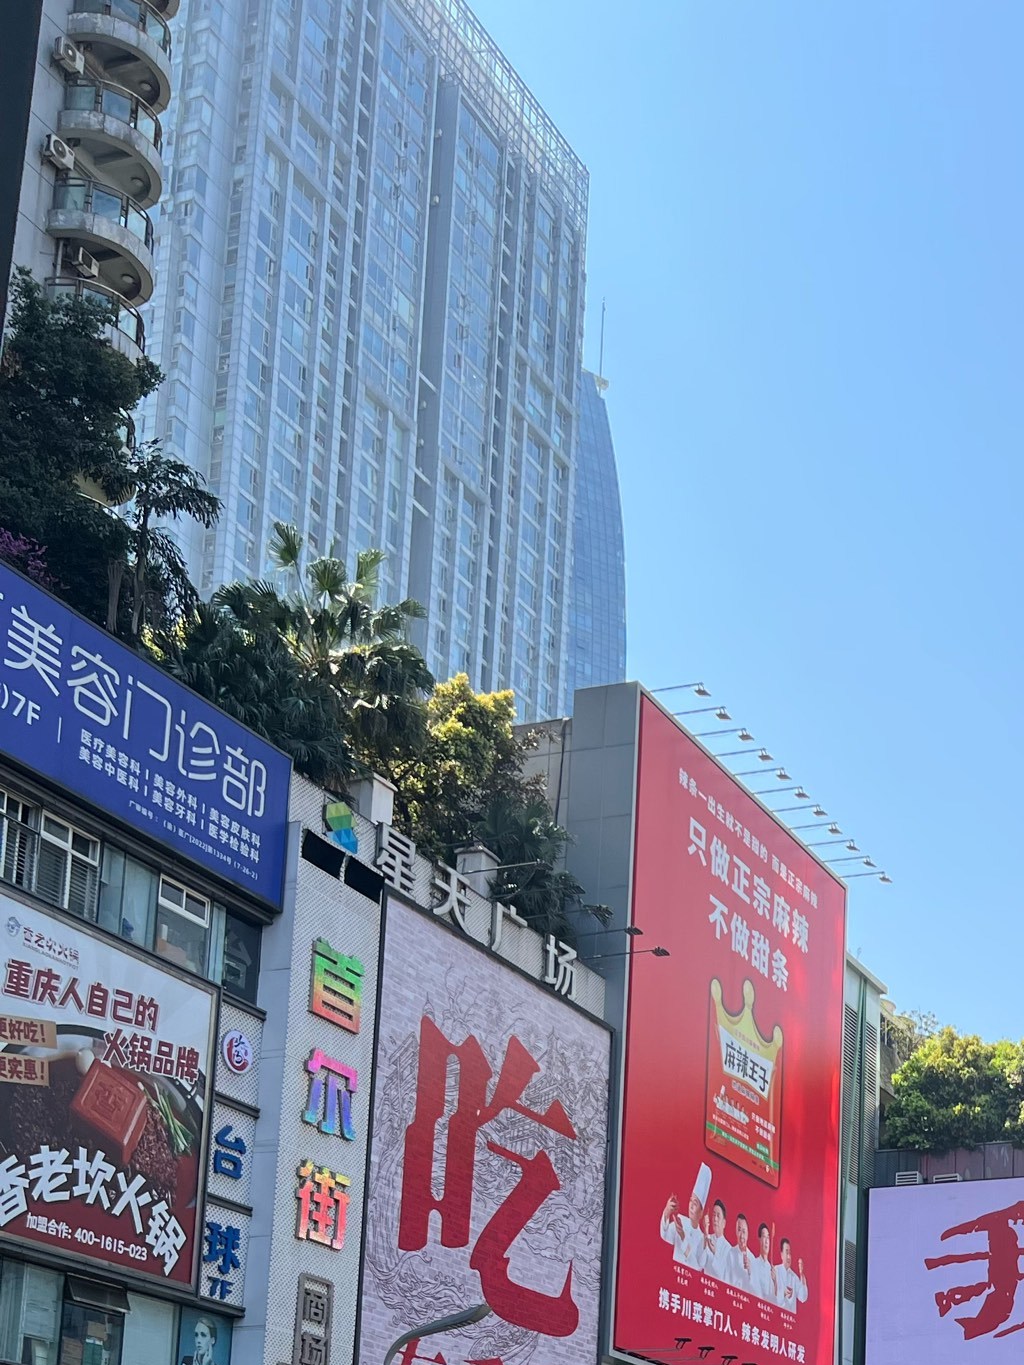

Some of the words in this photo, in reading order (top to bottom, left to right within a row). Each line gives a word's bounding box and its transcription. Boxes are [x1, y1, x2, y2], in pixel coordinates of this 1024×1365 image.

[0, 592, 266, 817] 美容门诊部
[79, 746, 139, 792] 美容中医科
[152, 790, 196, 826] 美容牙科
[208, 824, 260, 864] 医学检验科
[80, 728, 141, 776] 医疗美容科
[154, 773, 198, 811] 美容外科
[209, 807, 261, 849] 美容皮肤科
[377, 821, 577, 999] 星天广场
[688, 816, 809, 953] 只做正宗麻辣
[709, 894, 788, 992] 不做甜条
[4, 957, 160, 1032] 重庆人自己的
[102, 1028, 200, 1083] 火锅品牌
[294, 935, 366, 1251] 首尔街
[725, 1040, 769, 1092] 麻辣王子
[0, 1145, 187, 1277] 香老坎火锅
[201, 1124, 247, 1274] 台球
[398, 1014, 579, 1337] 吃
[74, 1227, 148, 1262] 400-1615-023
